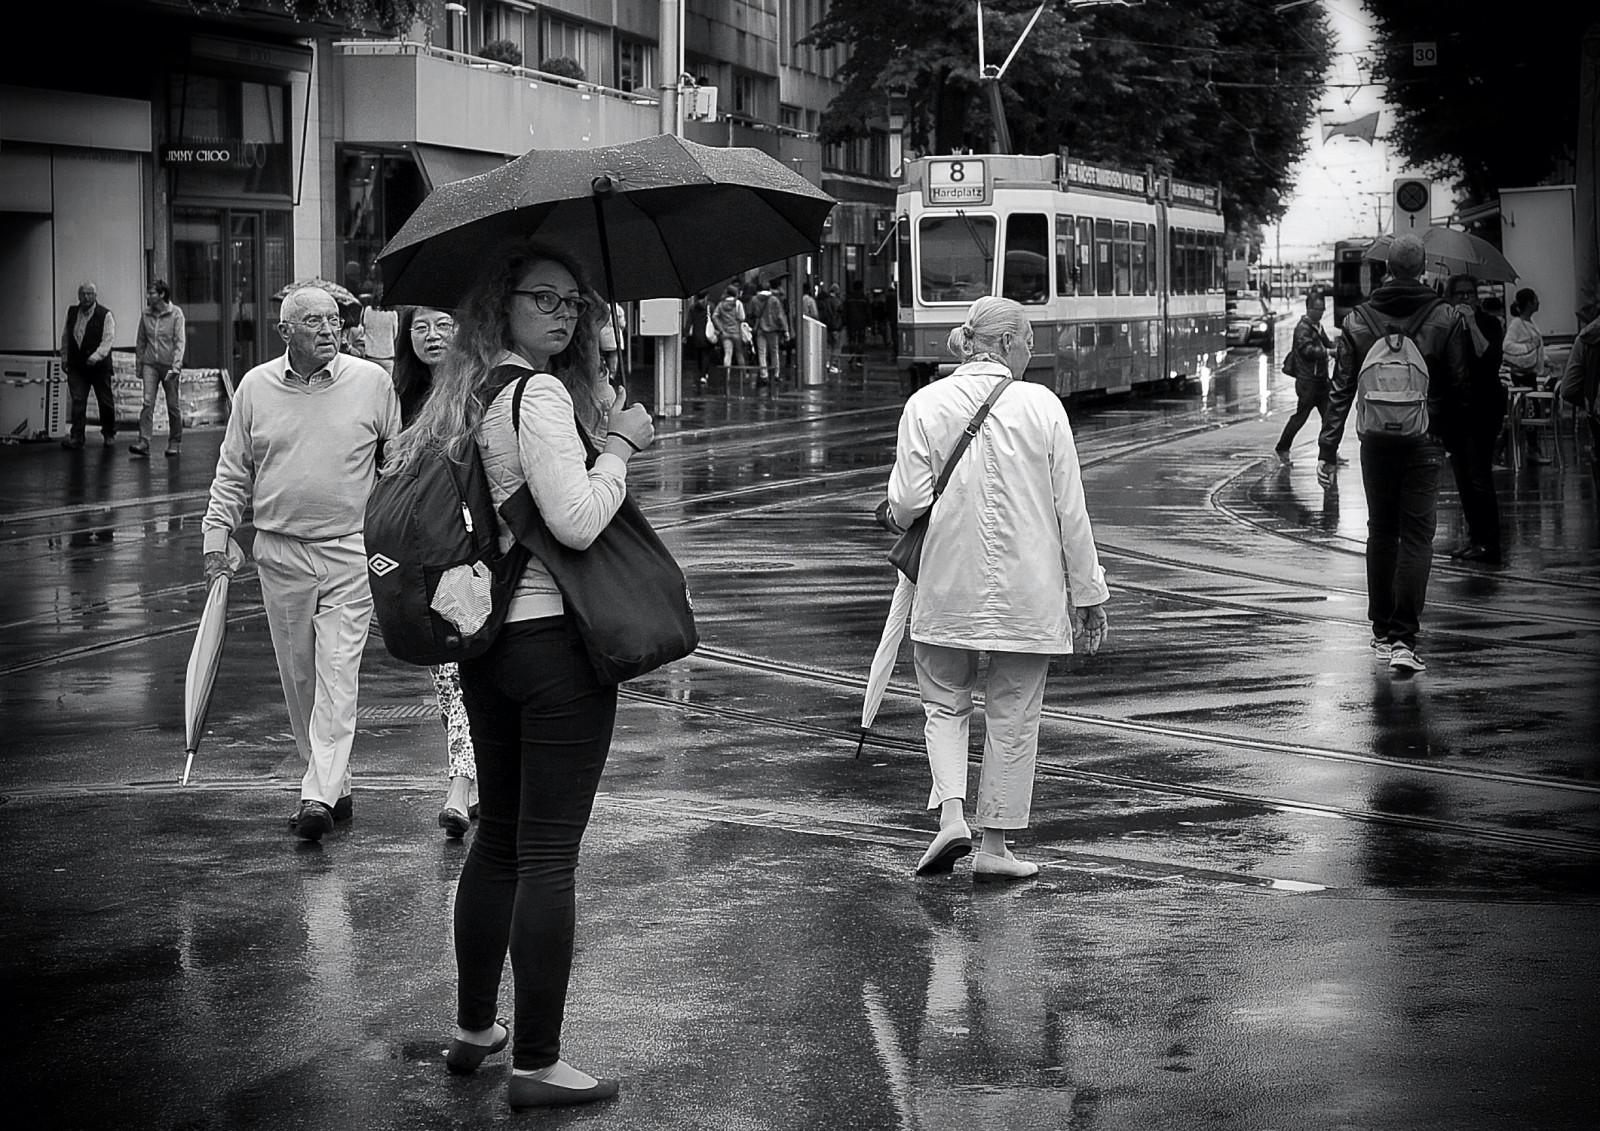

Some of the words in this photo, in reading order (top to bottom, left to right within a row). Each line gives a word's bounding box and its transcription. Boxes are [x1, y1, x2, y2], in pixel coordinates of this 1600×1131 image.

[1415, 48, 1435, 62] 30
[166, 150, 194, 162] JIMMY
[196, 150, 230, 162] CHOO
[950, 161, 965, 182] 8
[932, 188, 982, 198] Hardplatz
